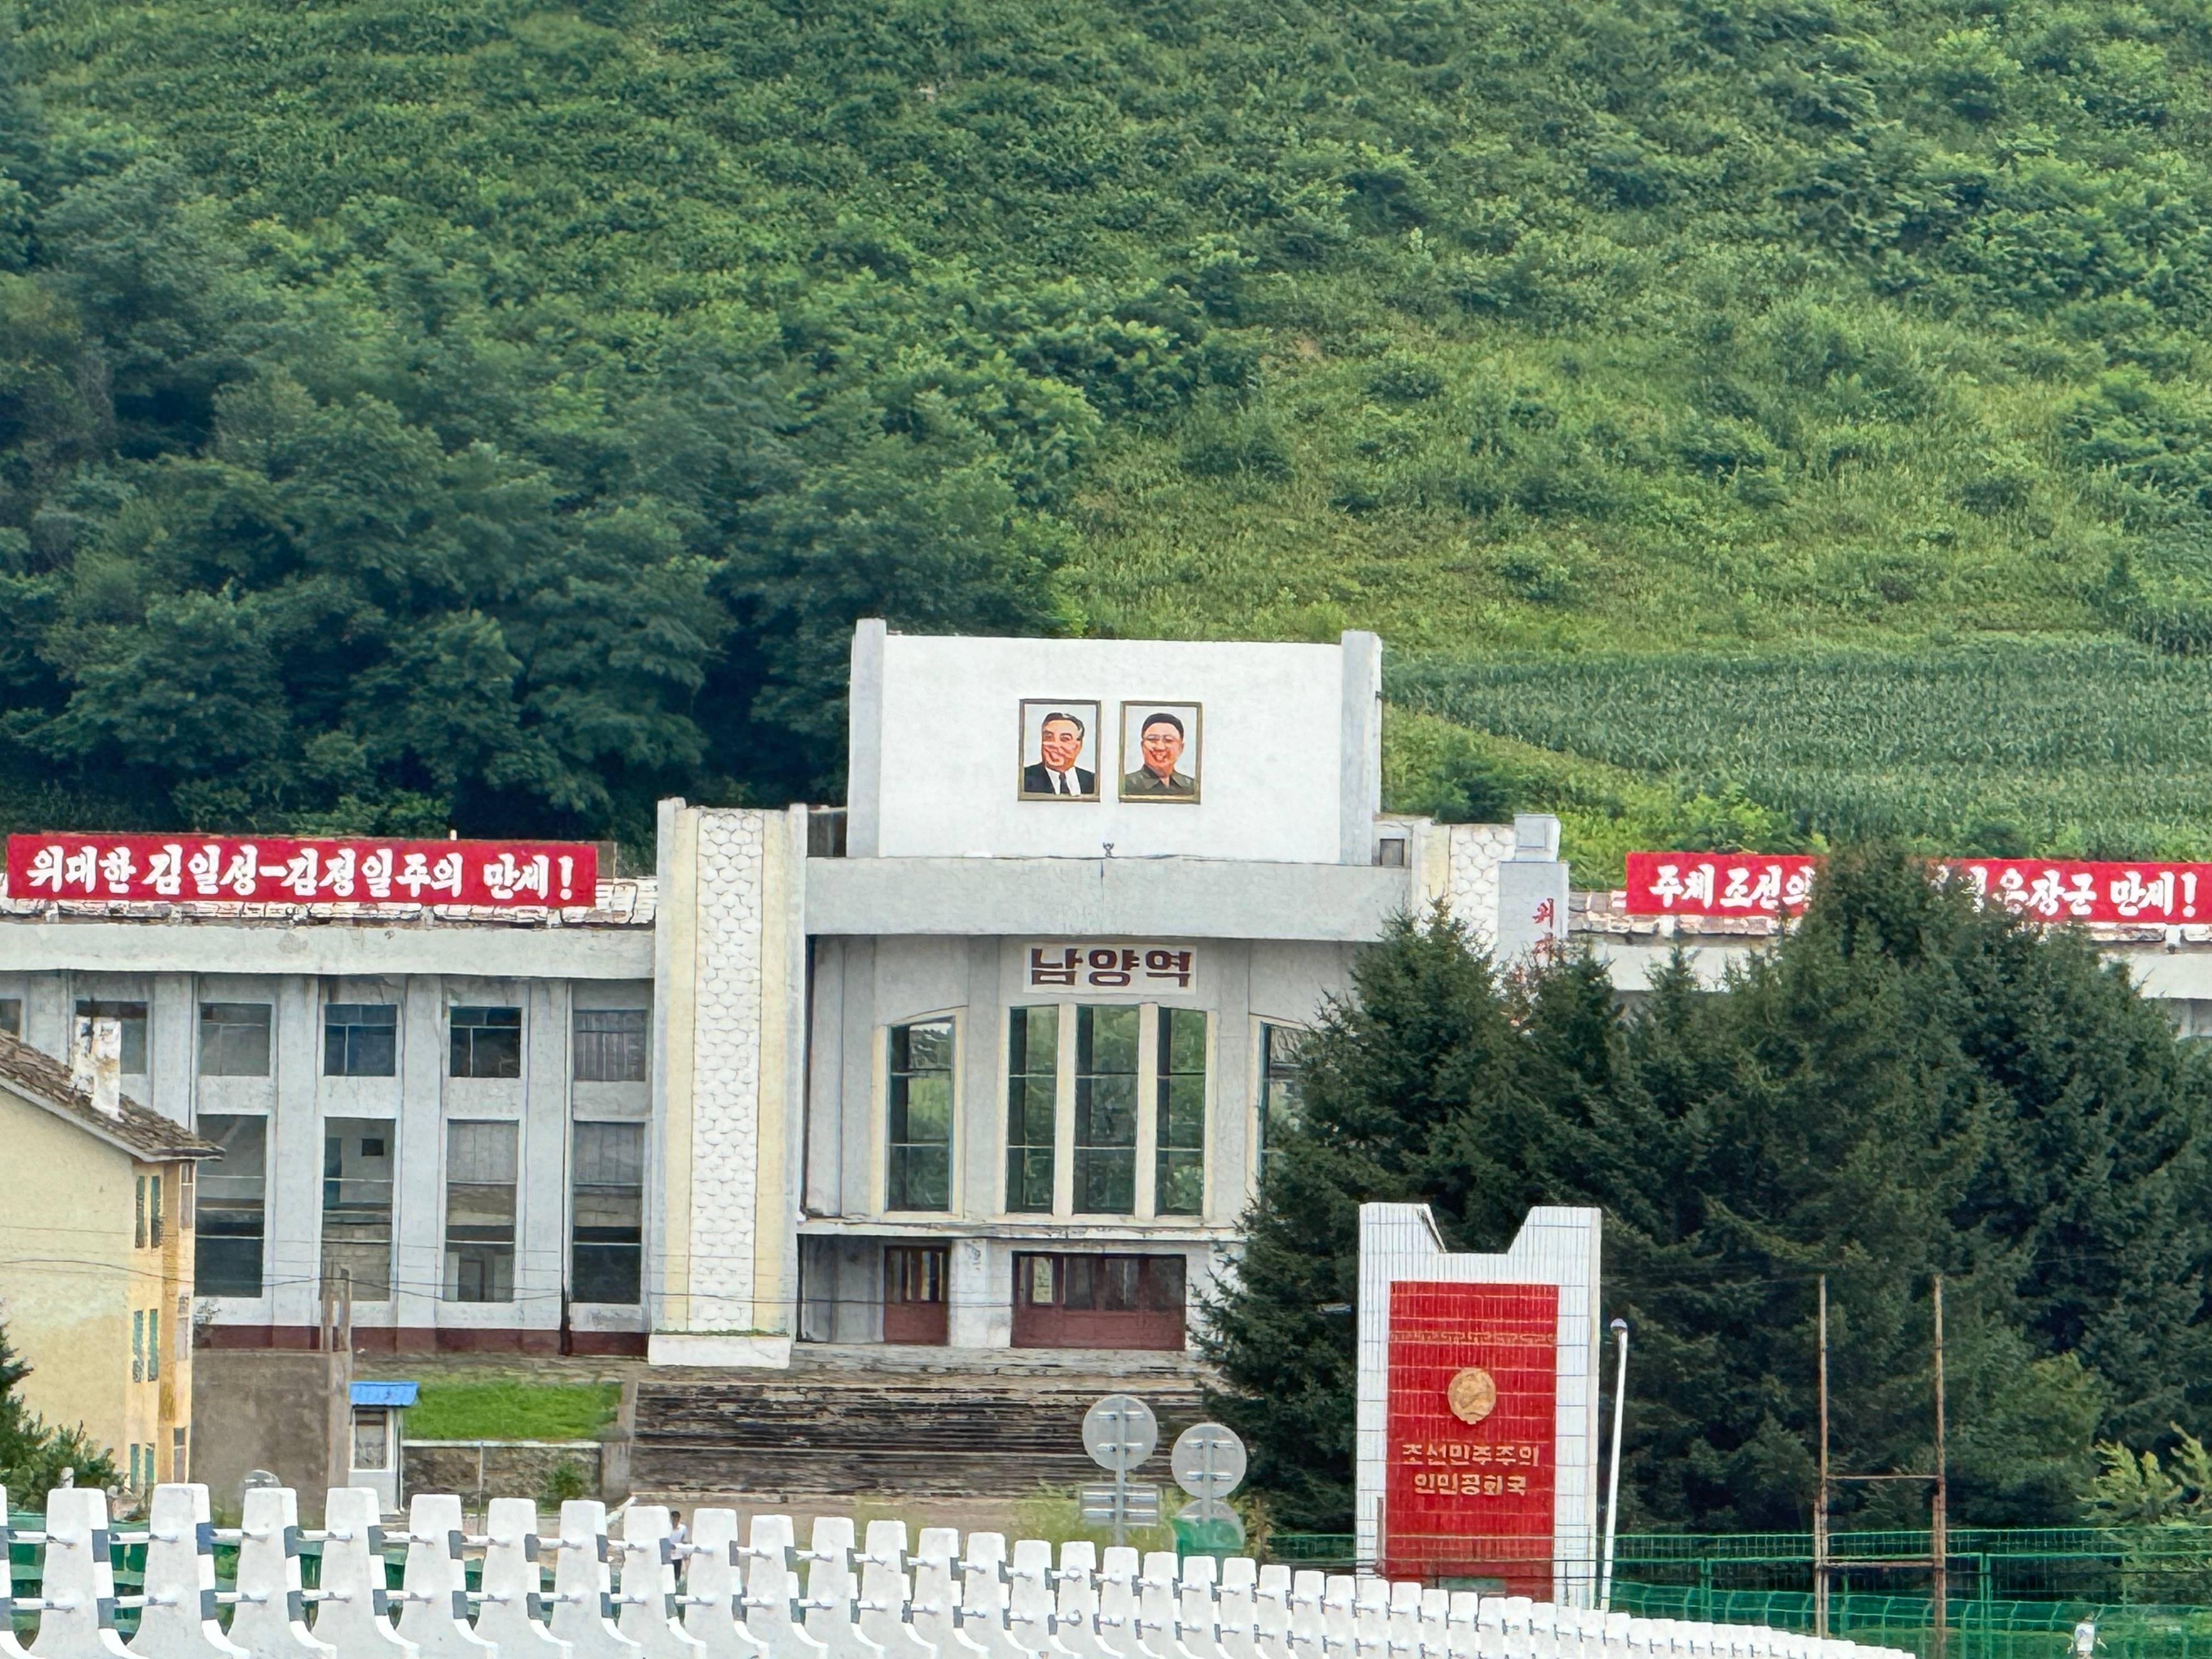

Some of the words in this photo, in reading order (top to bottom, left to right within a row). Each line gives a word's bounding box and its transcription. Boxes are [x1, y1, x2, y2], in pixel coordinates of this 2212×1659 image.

[27, 845, 136, 893] 위대한
[483, 853, 573, 900] 만세!
[2110, 871, 2197, 918] 만세!
[1031, 948, 1192, 988] 남양역
[1402, 1443, 1539, 1467] 조선민주주의
[1414, 1473, 1527, 1497] 인민공화국
